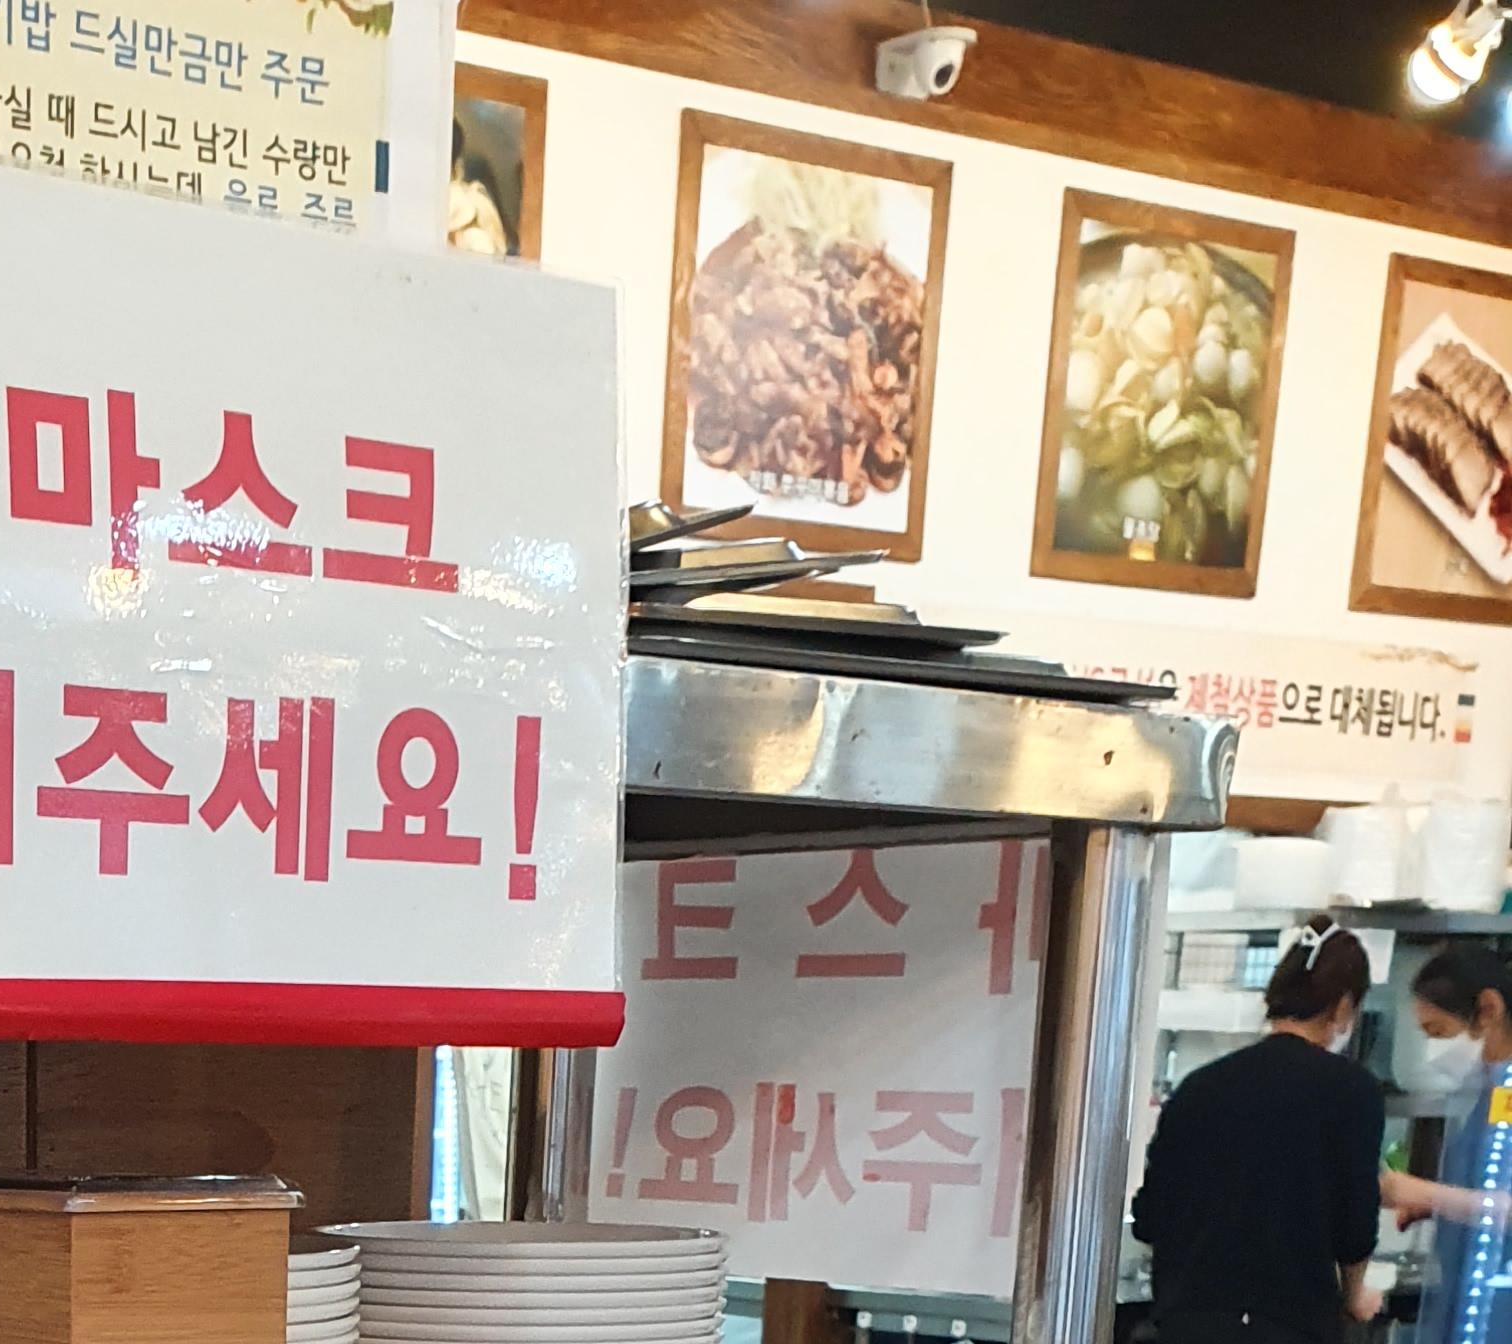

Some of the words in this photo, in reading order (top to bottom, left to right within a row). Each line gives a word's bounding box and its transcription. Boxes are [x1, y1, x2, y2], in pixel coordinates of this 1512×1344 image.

[69, 10, 249, 93] 드실만금만
[260, 48, 330, 107] 주문
[47, 92, 76, 140] 때
[88, 101, 182, 154] 드시고
[192, 121, 249, 169] 남긴
[261, 133, 352, 187] 수량만
[6, 386, 460, 592] 마스크
[1330, 685, 1447, 742] 대체됩니다.
